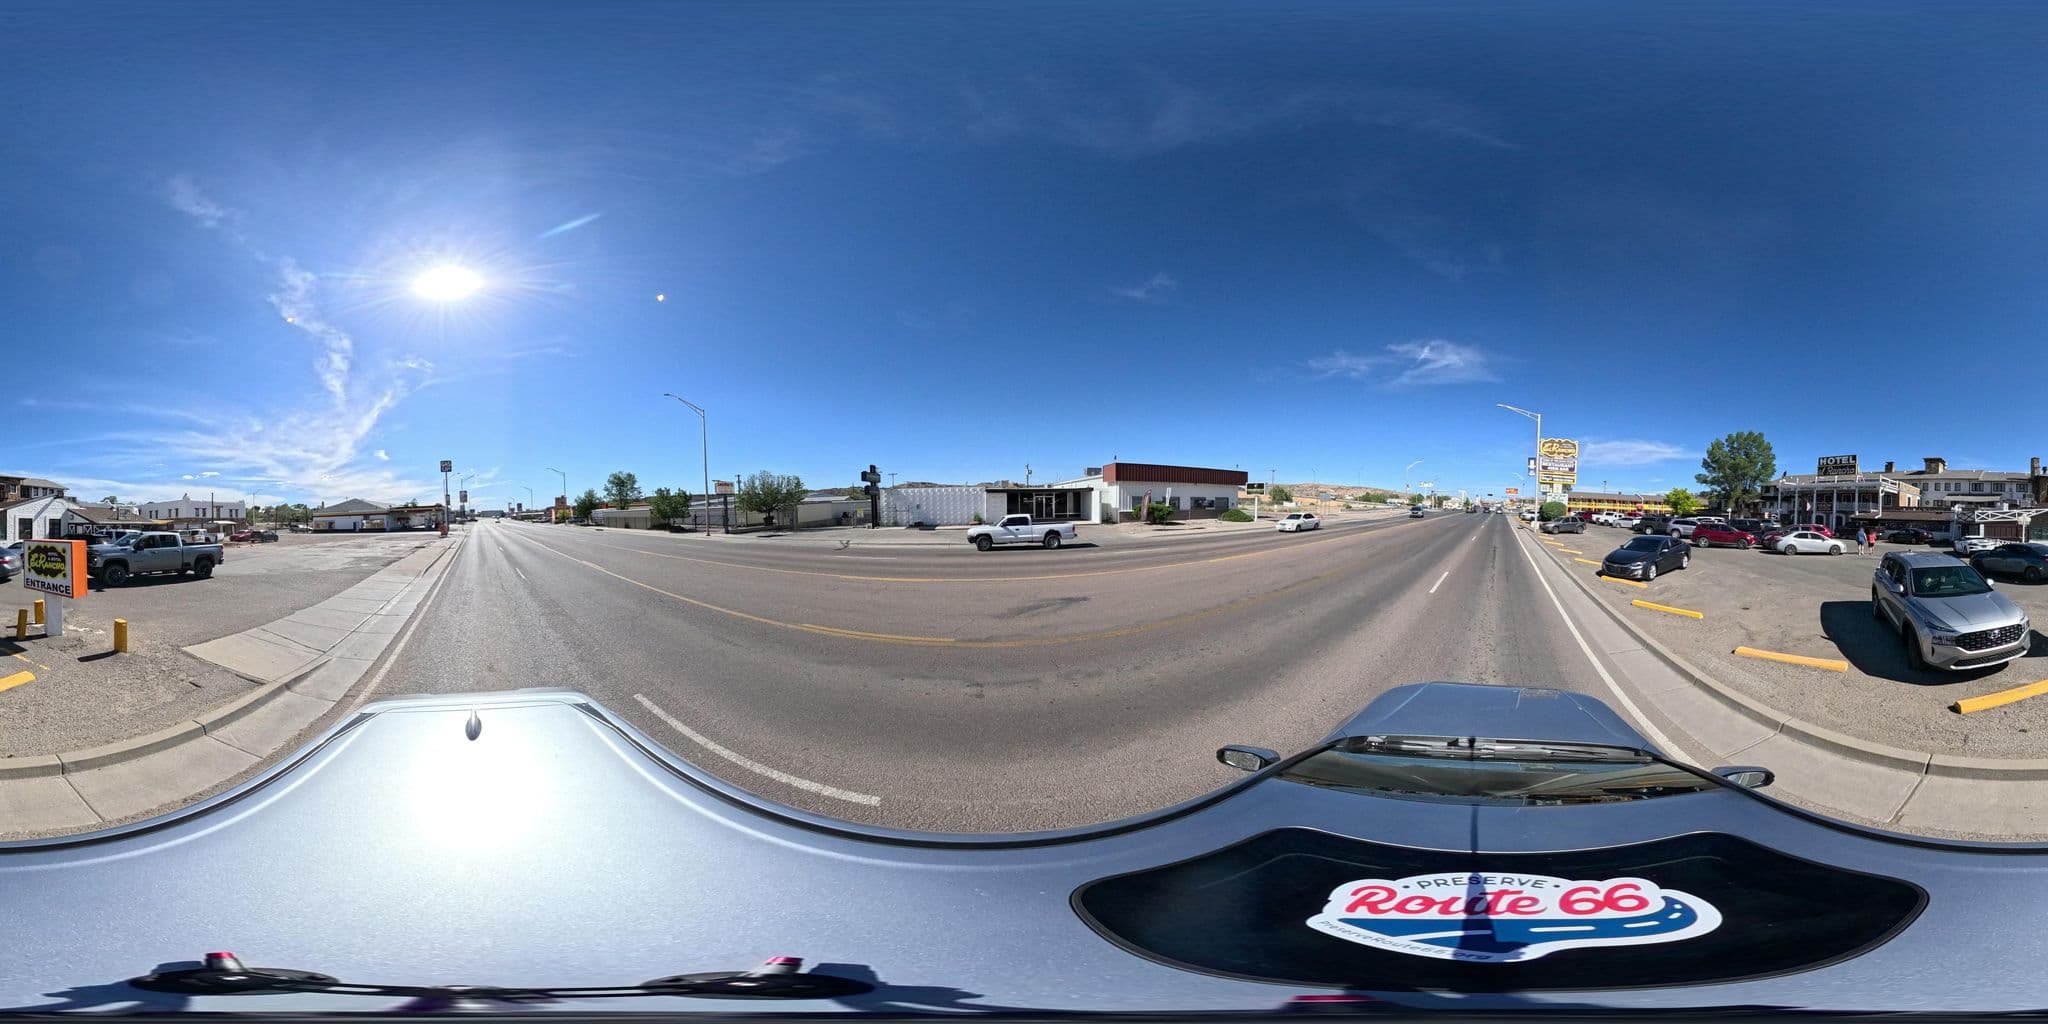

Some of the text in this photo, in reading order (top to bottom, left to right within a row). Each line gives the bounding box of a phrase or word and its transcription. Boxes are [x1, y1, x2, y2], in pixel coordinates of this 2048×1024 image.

[1820, 456, 1855, 465] HOTEL
[26, 578, 71, 594] ENTRANCE
[1416, 876, 1547, 889] PRESERVE
[1345, 883, 1650, 916] Route 66
